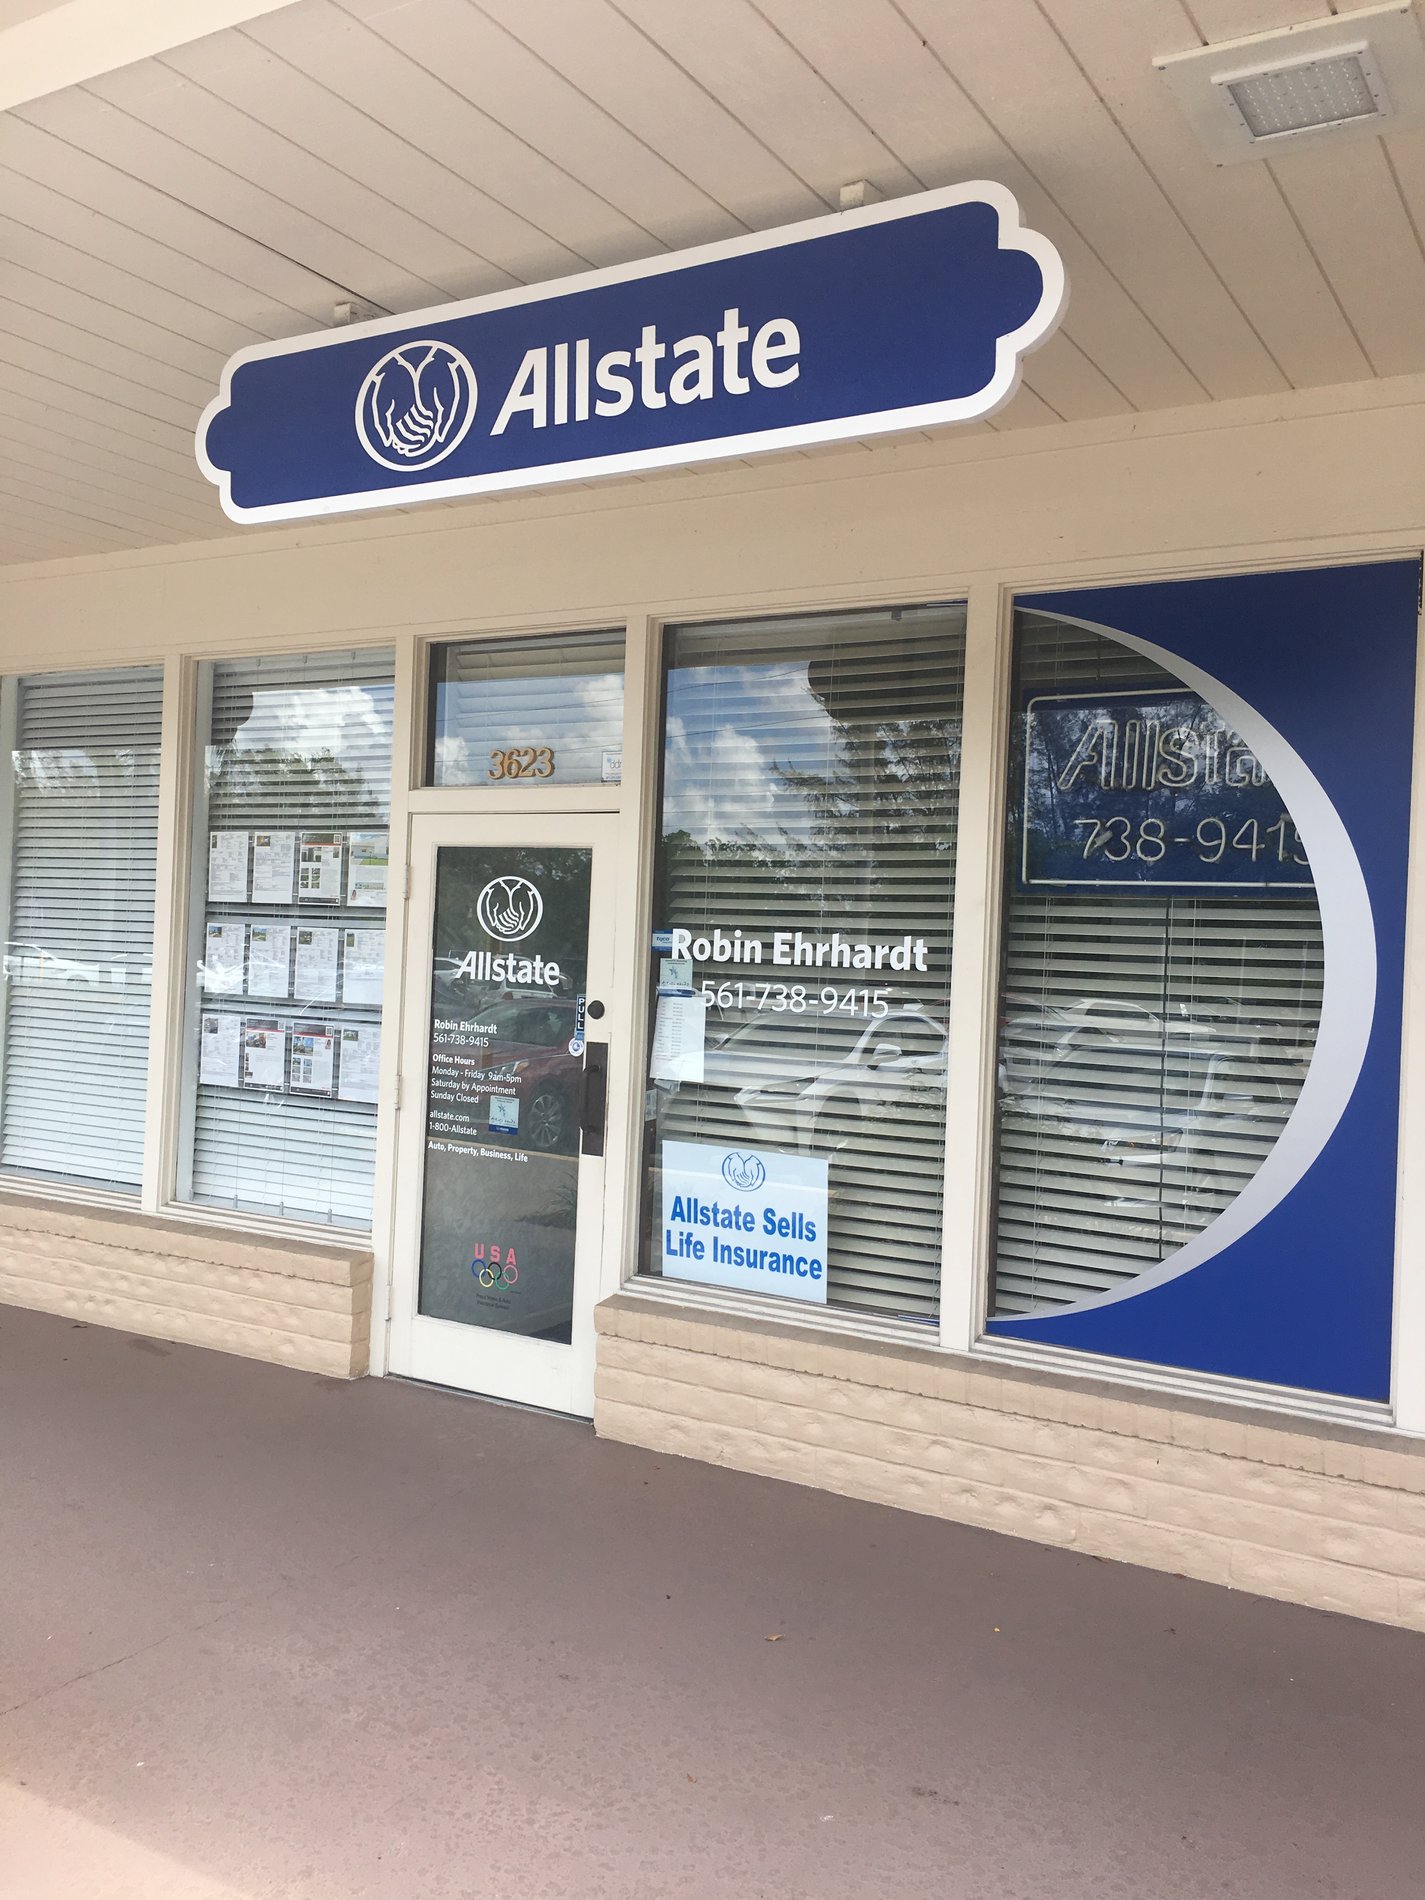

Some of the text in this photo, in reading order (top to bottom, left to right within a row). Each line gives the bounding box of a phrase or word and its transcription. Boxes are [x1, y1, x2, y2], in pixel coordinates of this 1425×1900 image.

[489, 307, 801, 436] Allstate
[488, 747, 556, 780] 3623
[671, 928, 929, 972] Robin Ehrhardt
[456, 951, 560, 986] Allstate
[701, 980, 890, 1019] 561-738-9415
[577, 998, 585, 1029] PULL
[434, 1019, 497, 1034] Robin Ehrhardt
[433, 1032, 489, 1048] 561-738-9415
[432, 1053, 475, 1066] Office Hours
[431, 1066, 459, 1078] Monday
[464, 1069, 485, 1080] Friday
[488, 1071, 522, 1084] 9am-5pm
[430, 1090, 479, 1104] Sunday Closed
[431, 1078, 516, 1096] Saturday by Appointment
[429, 1110, 470, 1122] allstate.com
[429, 1122, 477, 1136] 1-800-Allstate
[428, 1141, 529, 1163] Auto, Property, Business, Life
[670, 1195, 817, 1242] Allstate Sells
[475, 1243, 516, 1265] USA
[666, 1229, 823, 1281] Life Insurance
